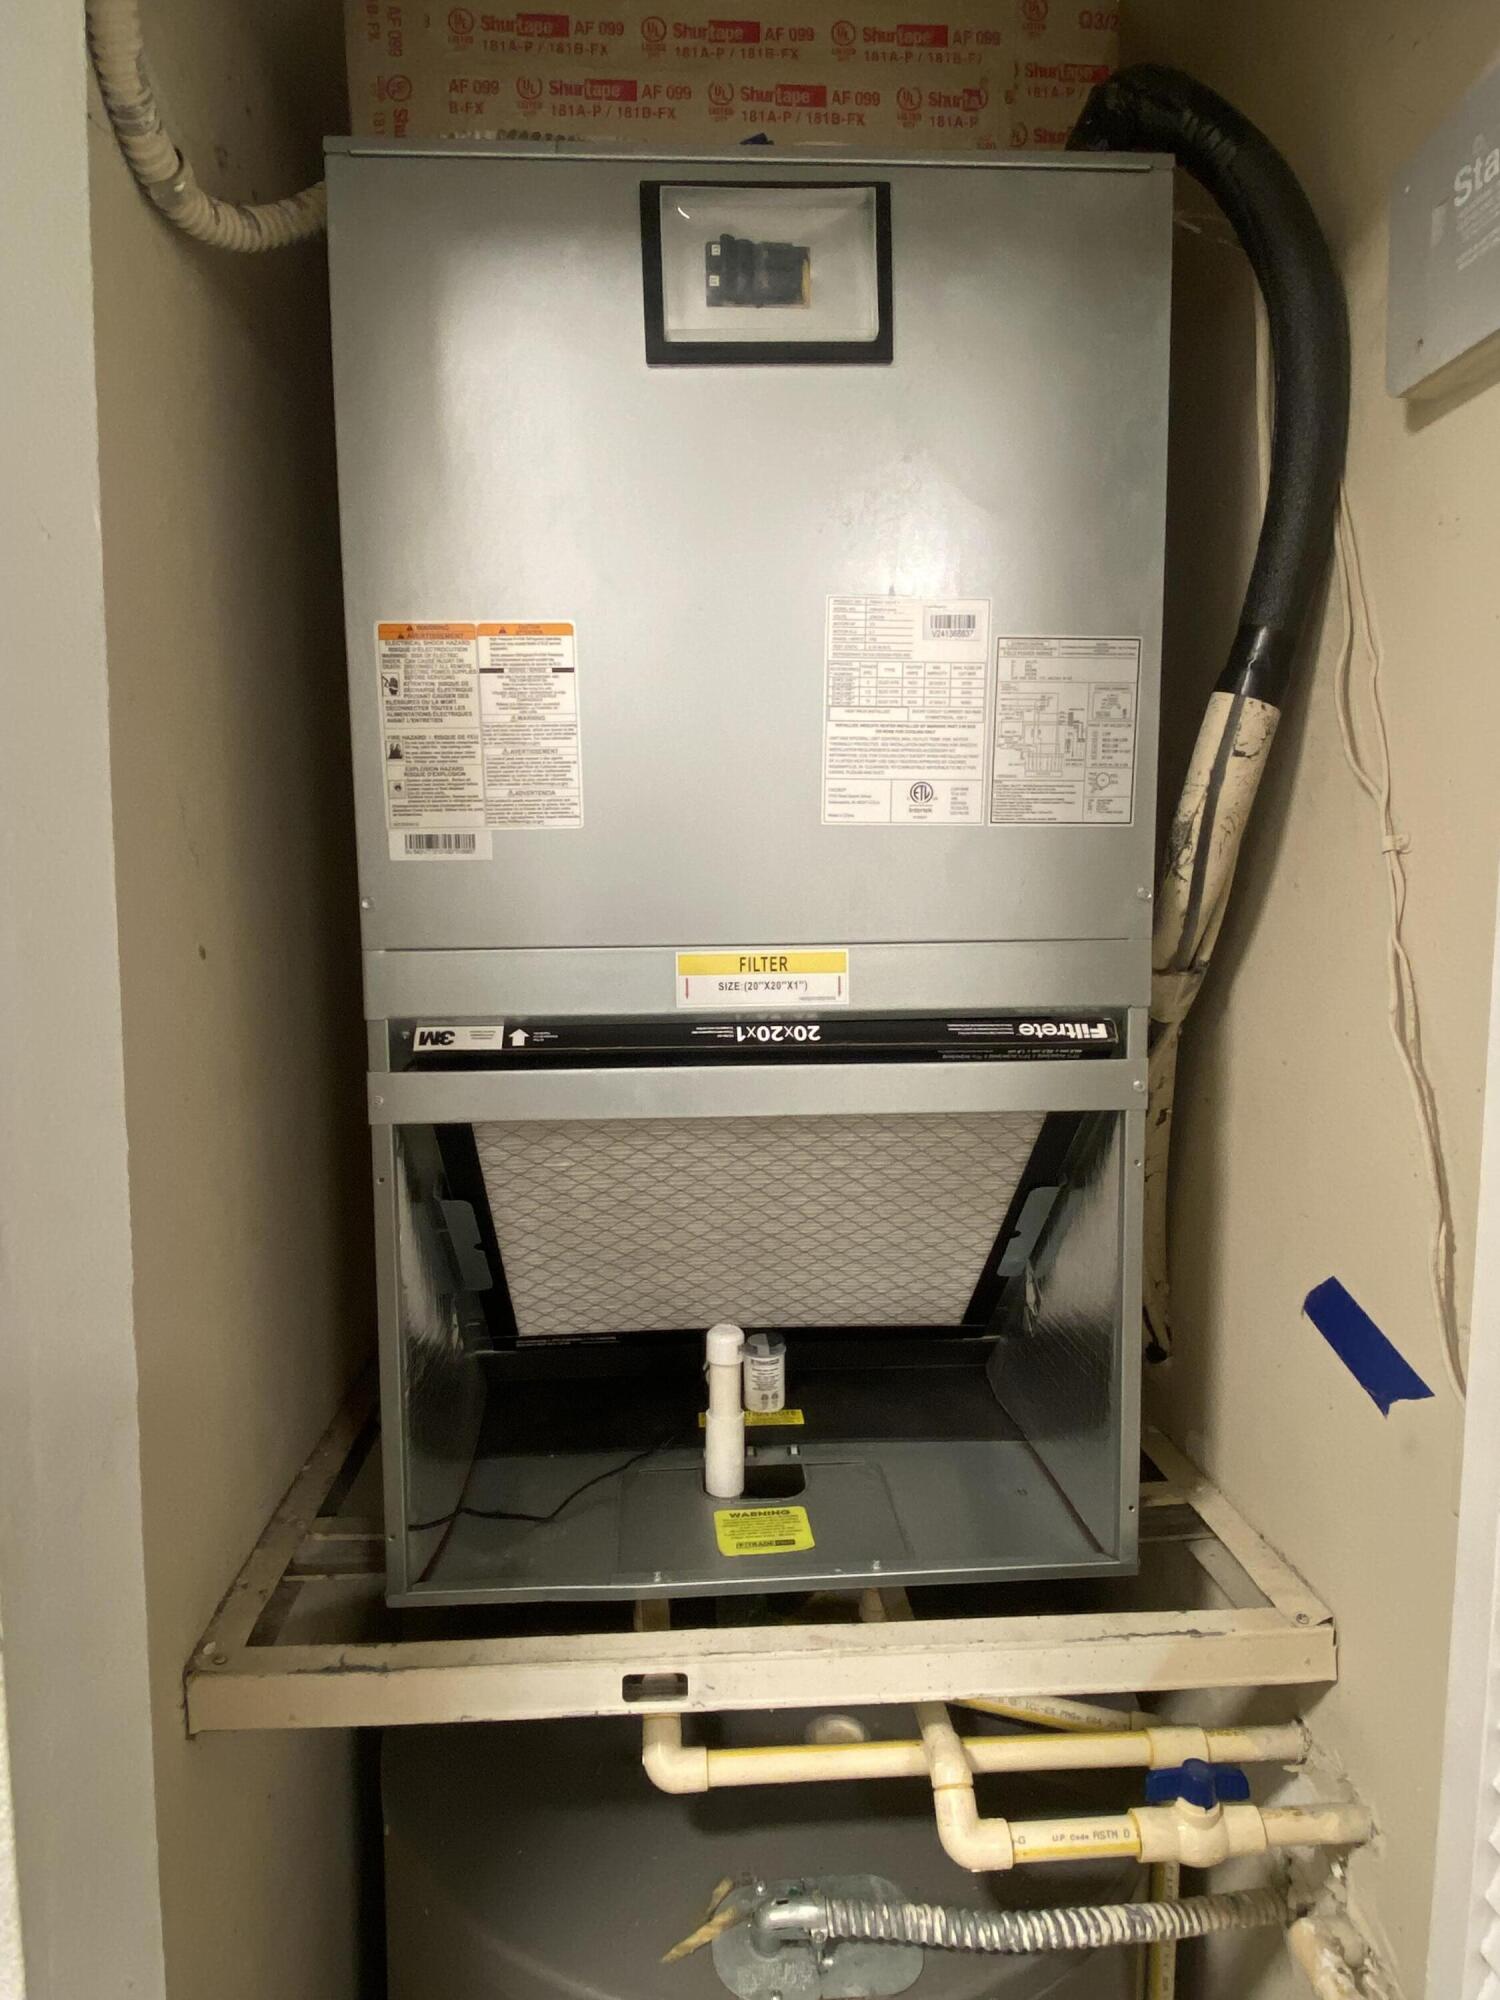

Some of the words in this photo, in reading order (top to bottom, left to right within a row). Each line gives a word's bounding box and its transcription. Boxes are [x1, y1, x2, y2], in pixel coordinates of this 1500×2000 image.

[481, 15, 558, 37] Shurtape
[574, 21, 594, 35] AF
[600, 22, 624, 36] 099
[673, 22, 746, 43] Shurtape
[764, 27, 785, 41] AF
[789, 27, 815, 42] 099
[863, 26, 936, 46] Shurtape
[953, 31, 972, 45] AF
[976, 32, 1001, 46] 099
[483, 40, 533, 51] 181A-P
[550, 43, 608, 56] 181B-FX
[675, 46, 723, 59] 181A-P
[741, 47, 800, 60] 181B-FX
[865, 51, 913, 63] 181A-P
[449, 79, 467, 94] AF
[473, 80, 499, 95] 099
[549, 80, 624, 100] Shurtape
[642, 84, 662, 99] AF
[667, 85, 692, 100] 099
[740, 86, 813, 106] Shurtape
[832, 90, 851, 105] AF
[855, 91, 881, 106] 099
[551, 104, 602, 117] 181A-P
[618, 106, 676, 119] 181B-FX
[741, 110, 792, 123] 181A-P
[807, 112, 865, 126] 181B-FX
[739, 956, 789, 973] FILTER
[418, 1030, 455, 1046] 3M
[736, 1025, 821, 1042] 20x20x1
[1018, 1023, 1108, 1039] Filtrete
[729, 1509, 791, 1518] WARNING
[1093, 1830, 1118, 1840] ASTM
